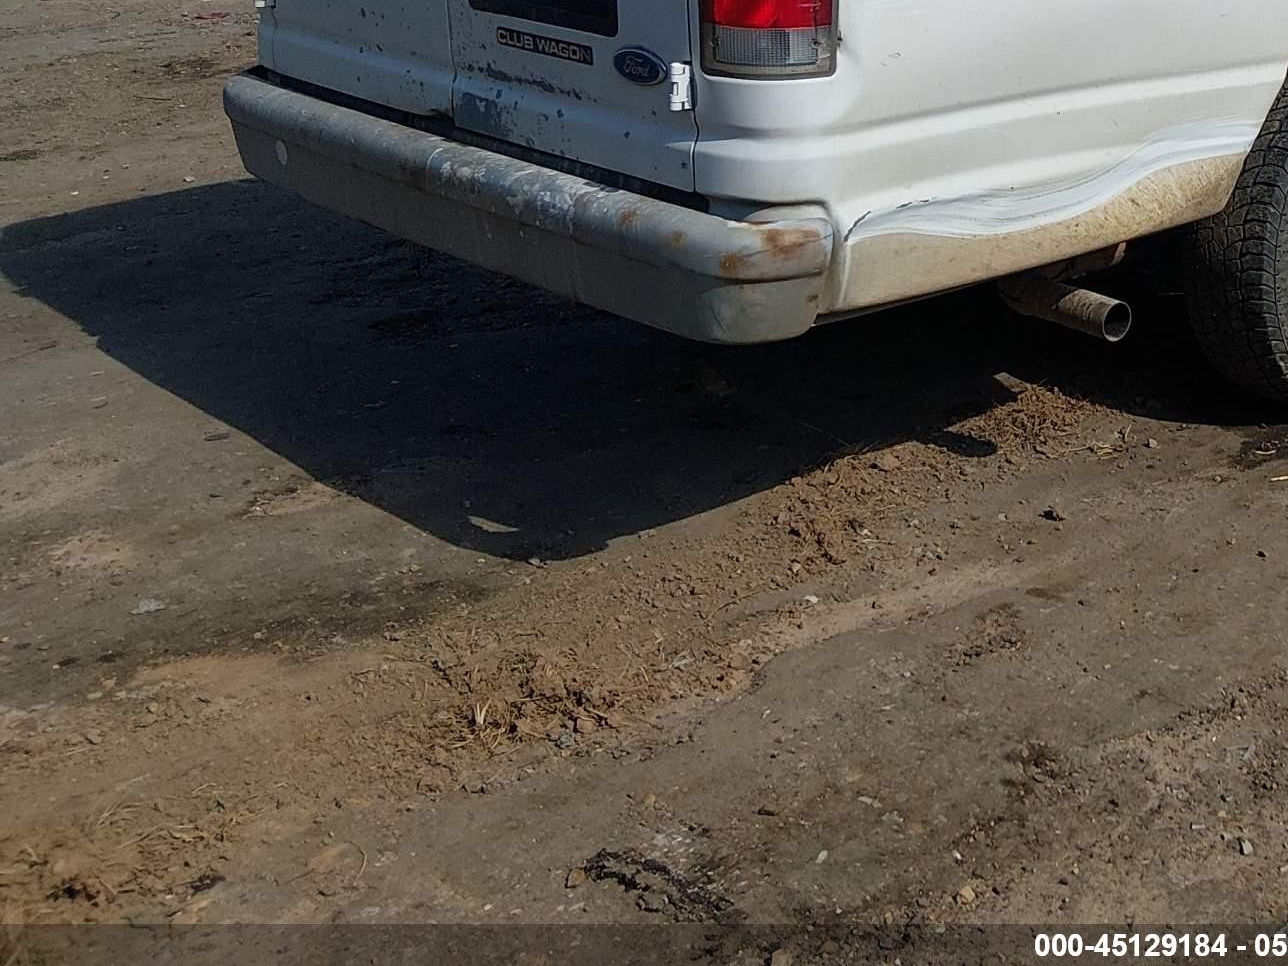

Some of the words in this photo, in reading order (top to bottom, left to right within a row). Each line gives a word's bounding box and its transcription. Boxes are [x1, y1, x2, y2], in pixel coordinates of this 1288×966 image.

[497, 29, 534, 50] CLUB
[536, 38, 593, 63] WAGON
[623, 55, 650, 77] Ford
